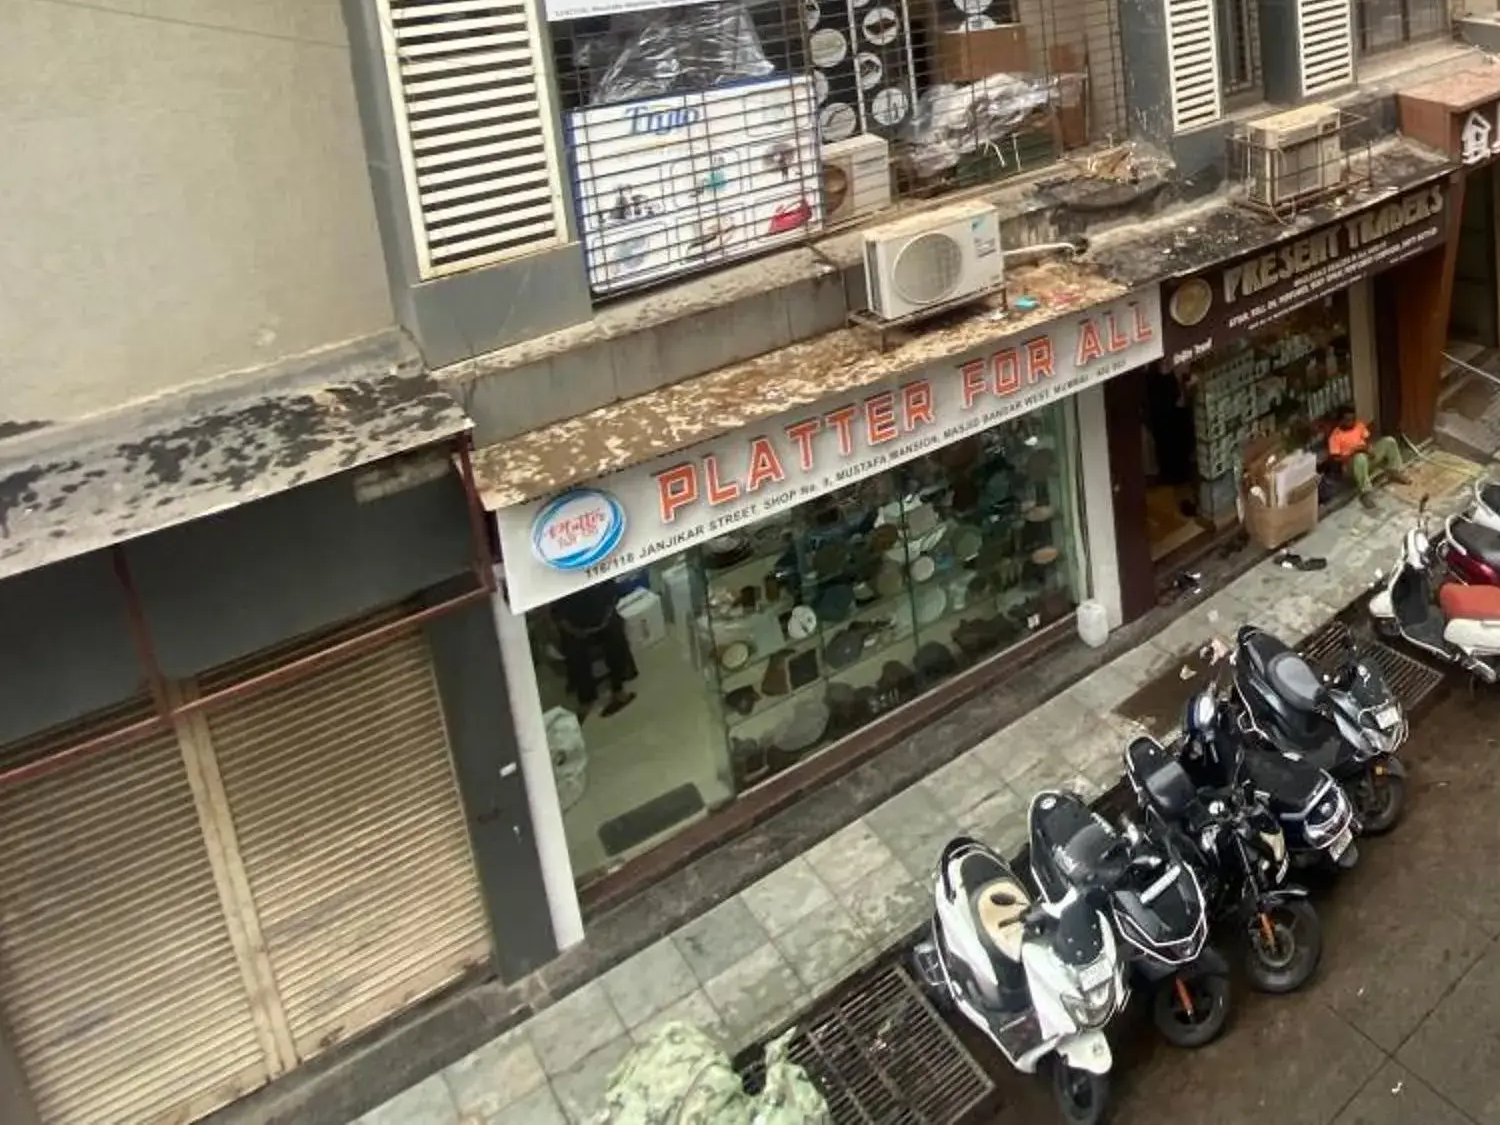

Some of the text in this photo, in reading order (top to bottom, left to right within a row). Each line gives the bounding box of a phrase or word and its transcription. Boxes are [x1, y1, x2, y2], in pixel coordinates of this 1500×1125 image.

[1223, 225, 1341, 304] PRESENT
[1344, 184, 1444, 249] TRADERS
[656, 301, 1152, 524] PLATTER FOR ALL
[639, 524, 705, 558] JANJIKAR
[763, 490, 797, 510] SHOP
[836, 455, 887, 480] MUSTAFA
